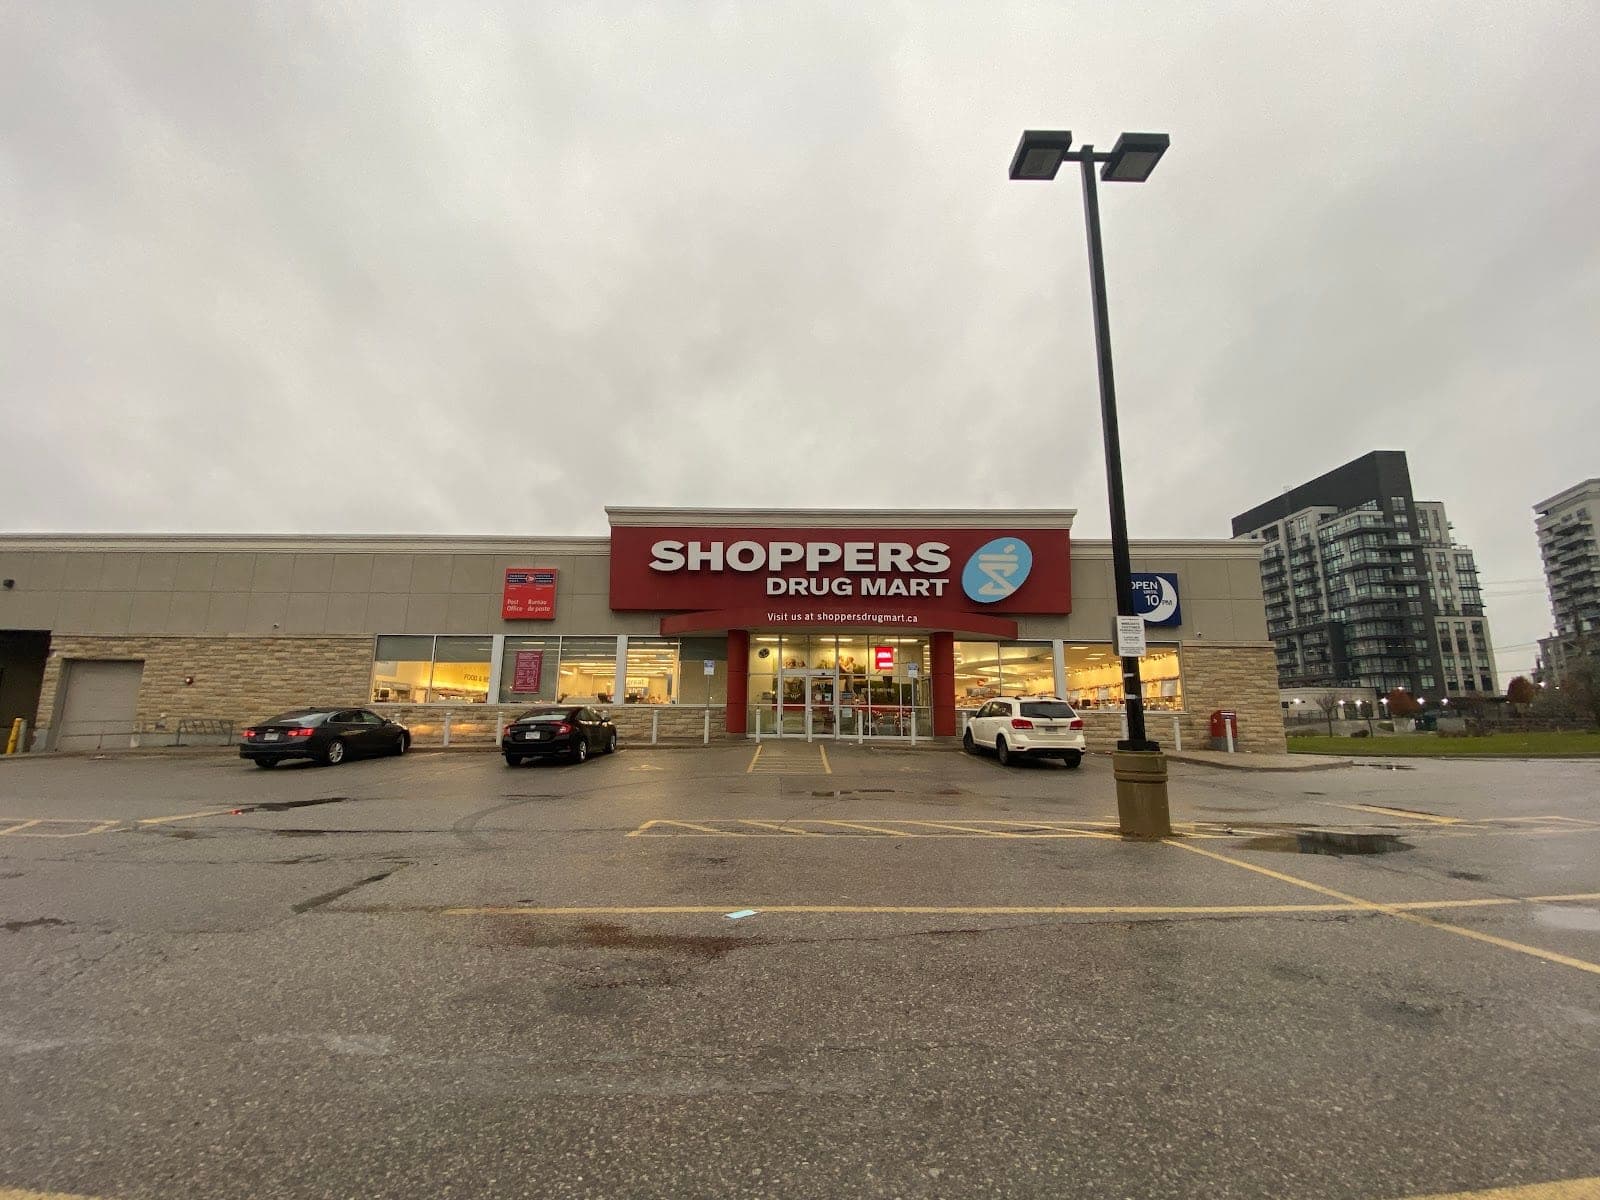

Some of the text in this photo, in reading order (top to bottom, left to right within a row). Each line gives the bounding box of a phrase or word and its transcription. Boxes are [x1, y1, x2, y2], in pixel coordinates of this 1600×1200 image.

[648, 540, 951, 572] SHOPPERS
[766, 577, 950, 597] DRUG MART
[1145, 595, 1159, 606] 10
[767, 612, 918, 623] Visit us at shoppersdrugmart.ca
